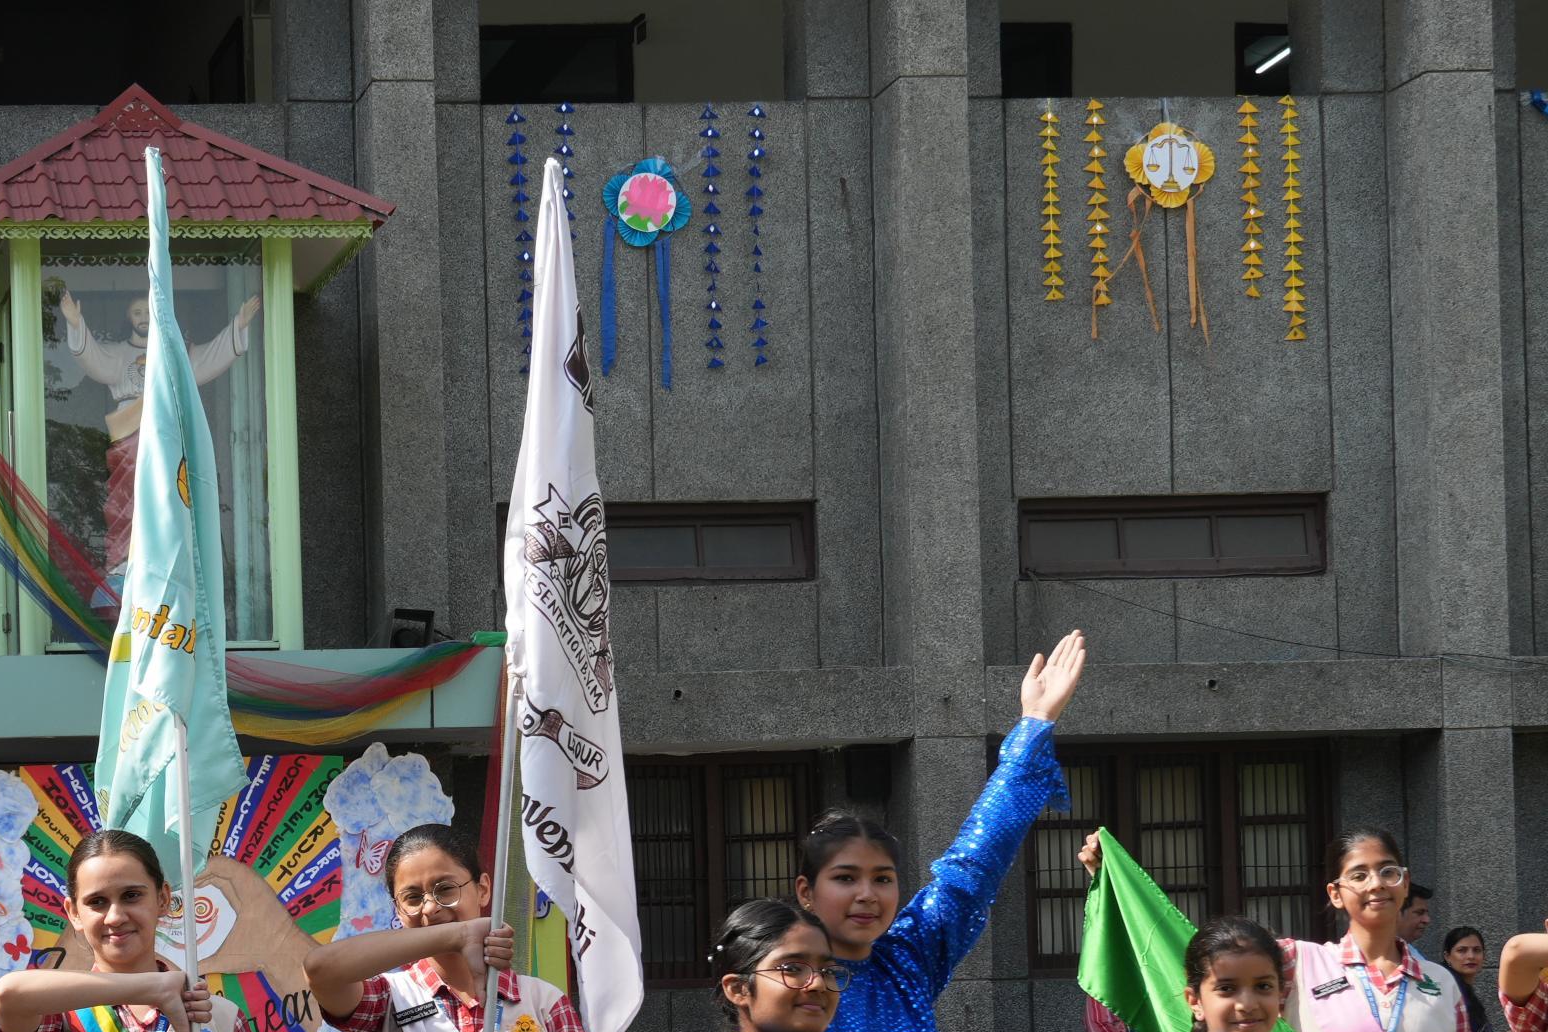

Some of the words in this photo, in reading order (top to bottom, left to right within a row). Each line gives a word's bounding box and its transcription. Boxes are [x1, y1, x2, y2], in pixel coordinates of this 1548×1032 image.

[61, 765, 103, 833] TRUTH
[222, 754, 273, 858] EFFICIENT
[276, 810, 332, 882] TRUST
[281, 847, 342, 903] BRAVE
[21, 888, 68, 916] LOV
[288, 874, 341, 917] KIND
